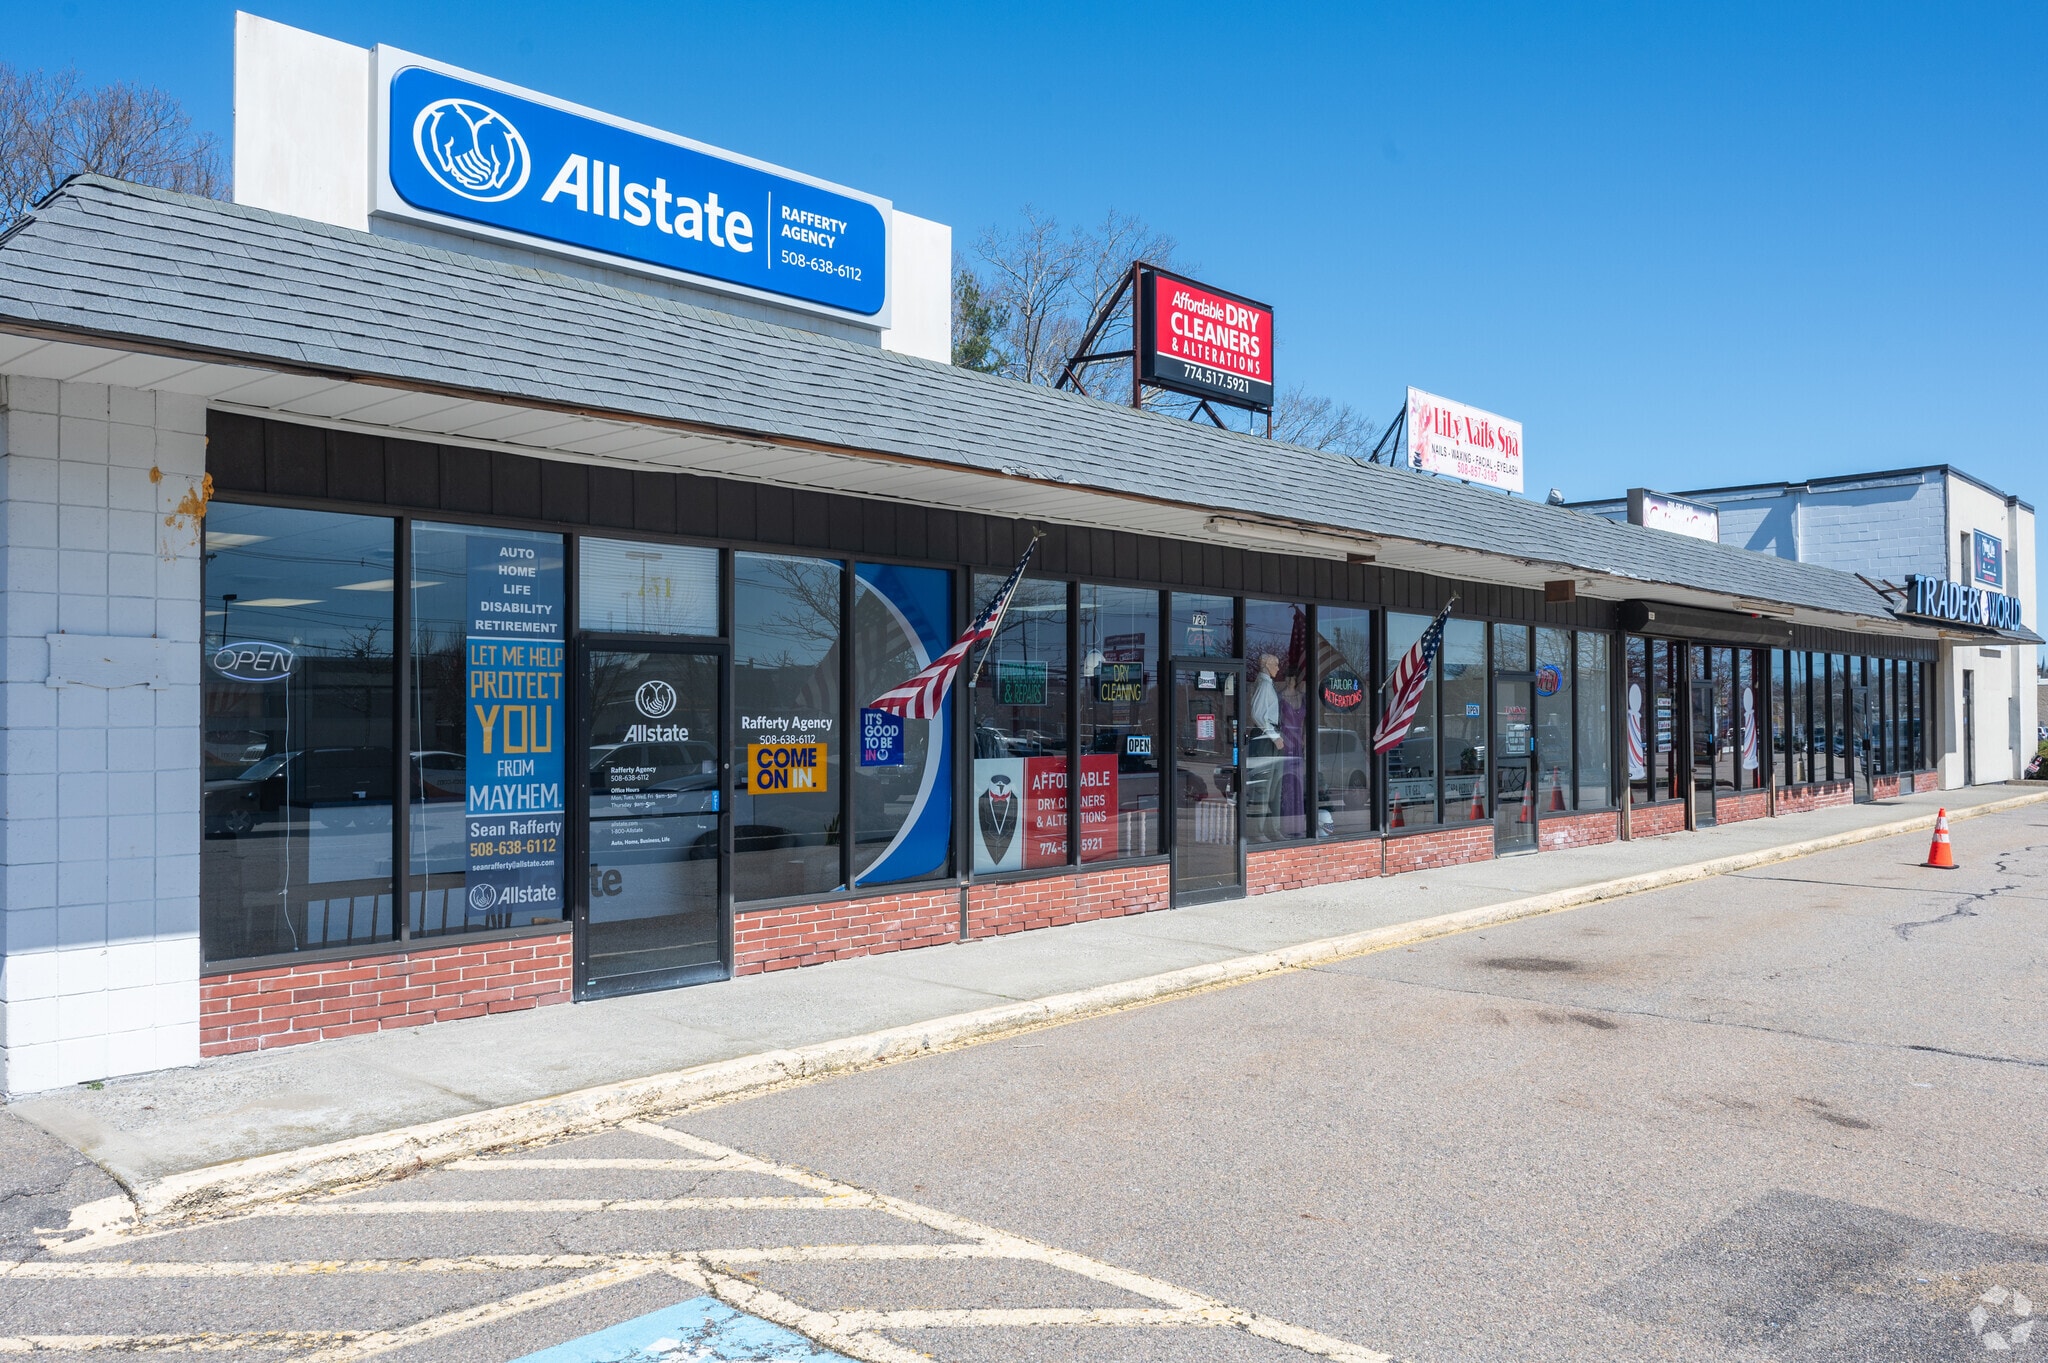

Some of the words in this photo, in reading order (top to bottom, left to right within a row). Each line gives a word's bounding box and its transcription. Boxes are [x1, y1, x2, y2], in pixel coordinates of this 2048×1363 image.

[541, 153, 754, 253] Allstate
[781, 205, 848, 235] RAFFERTY
[781, 224, 837, 249] AGENCY
[781, 249, 863, 282] 508-638-6112
[1172, 291, 1224, 321] Affordable
[1225, 303, 1260, 333] DRY
[1171, 311, 1260, 358] CLEANERS
[1171, 337, 1179, 352] &
[1183, 340, 1260, 375] ALTERATIONS
[1184, 364, 1249, 394] 774.517.5921
[1465, 416, 1495, 449] Nails
[1497, 426, 1519, 459] Spa
[1431, 443, 1447, 457] NAILS
[1451, 449, 1471, 463] WAXING
[1476, 455, 1493, 469] FACIAL
[1497, 460, 1518, 475] EYELASH
[500, 546, 535, 559] AUTO
[498, 565, 536, 577] HOME
[503, 584, 531, 595] LIFE
[481, 601, 552, 614] DISABILITY
[1988, 591, 2022, 632] WORLD
[475, 619, 558, 633] RETIREMENT
[1193, 615, 1207, 625] 729
[213, 649, 294, 672] OPEN
[471, 644, 497, 666] LET
[502, 646, 524, 666] ME
[529, 647, 563, 667] HELP
[1113, 664, 1130, 682] DRY
[470, 670, 562, 699] PROTECT
[1014, 683, 1042, 703] REPAIRS
[1101, 683, 1142, 701] CLEANING
[1329, 677, 1353, 690] TAILOR
[1353, 679, 1359, 690] &
[1324, 687, 1363, 707] ALTERATIONS
[741, 716, 789, 732] Rafferty
[791, 716, 833, 731] Agency
[865, 713, 882, 725] IT'S
[474, 704, 552, 754] YOU
[623, 723, 689, 742] Allstate
[864, 725, 899, 737] GOOD
[760, 734, 816, 745] 508-638-6112
[865, 737, 879, 749] TO
[880, 737, 893, 748] BE
[1128, 738, 1150, 753] OPEN
[757, 748, 817, 769] COME
[865, 749, 876, 761] IN
[497, 759, 534, 777] FROM
[610, 766, 635, 774] Rafferty
[635, 766, 657, 774] Agency
[610, 774, 650, 782] 508-638-6112
[757, 769, 788, 789] ON
[792, 768, 817, 789] IN.
[1032, 771, 1110, 790] AFFOABLE
[470, 783, 562, 811] MAYHEM.
[1038, 797, 1056, 811] DRY
[1036, 816, 1044, 828] &
[1046, 810, 1107, 827] ALTETIONS
[470, 822, 506, 838] Sean
[510, 820, 562, 836] Rafferty
[470, 838, 556, 857] 508-638-6112
[472, 860, 555, 872] seanrafferty@allstate.com
[498, 884, 557, 905] Allstate
